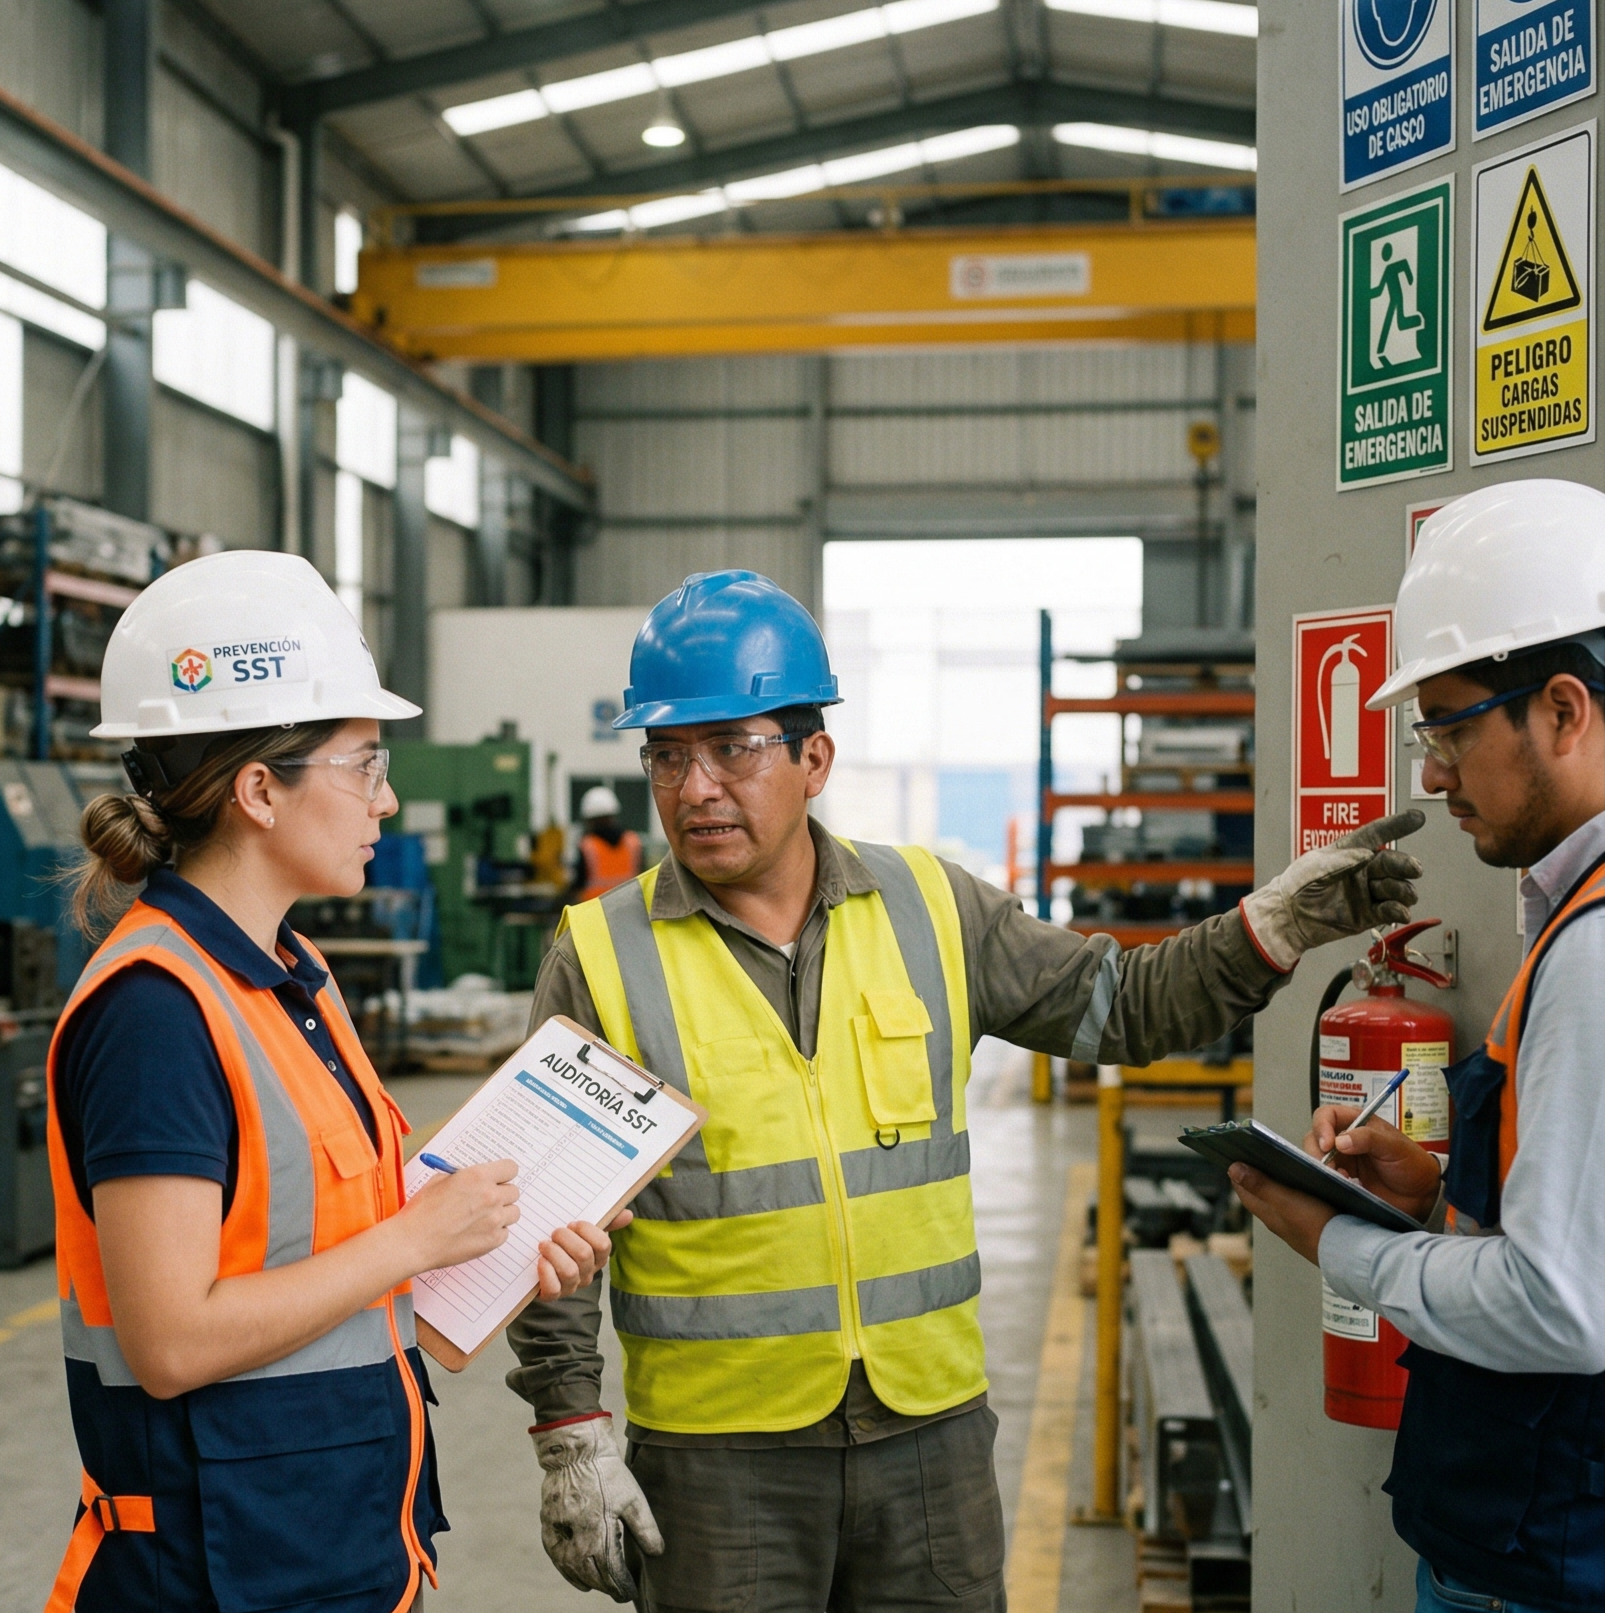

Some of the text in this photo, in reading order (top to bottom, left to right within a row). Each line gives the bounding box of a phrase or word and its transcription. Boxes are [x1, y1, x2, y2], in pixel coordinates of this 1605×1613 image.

[1490, 8, 1575, 73] SALIDA DE
[1480, 44, 1586, 116] EMERGENCIA
[1346, 71, 1448, 137] USO OBLIGATORIO
[1368, 113, 1425, 160] DE CASCO
[1491, 335, 1572, 382] PELIGRO
[1355, 389, 1433, 433] SALIDA DE
[1501, 372, 1559, 408] CARGAS
[1481, 397, 1582, 442] SUSPENDIDAS
[1345, 423, 1444, 470] EMERGENCIA
[213, 636, 301, 659] PREVENCIÓN
[232, 656, 286, 683] SST
[1323, 802, 1360, 826] FIRE
[539, 1053, 624, 1116] AUDITORÍA
[622, 1108, 658, 1135] SST
